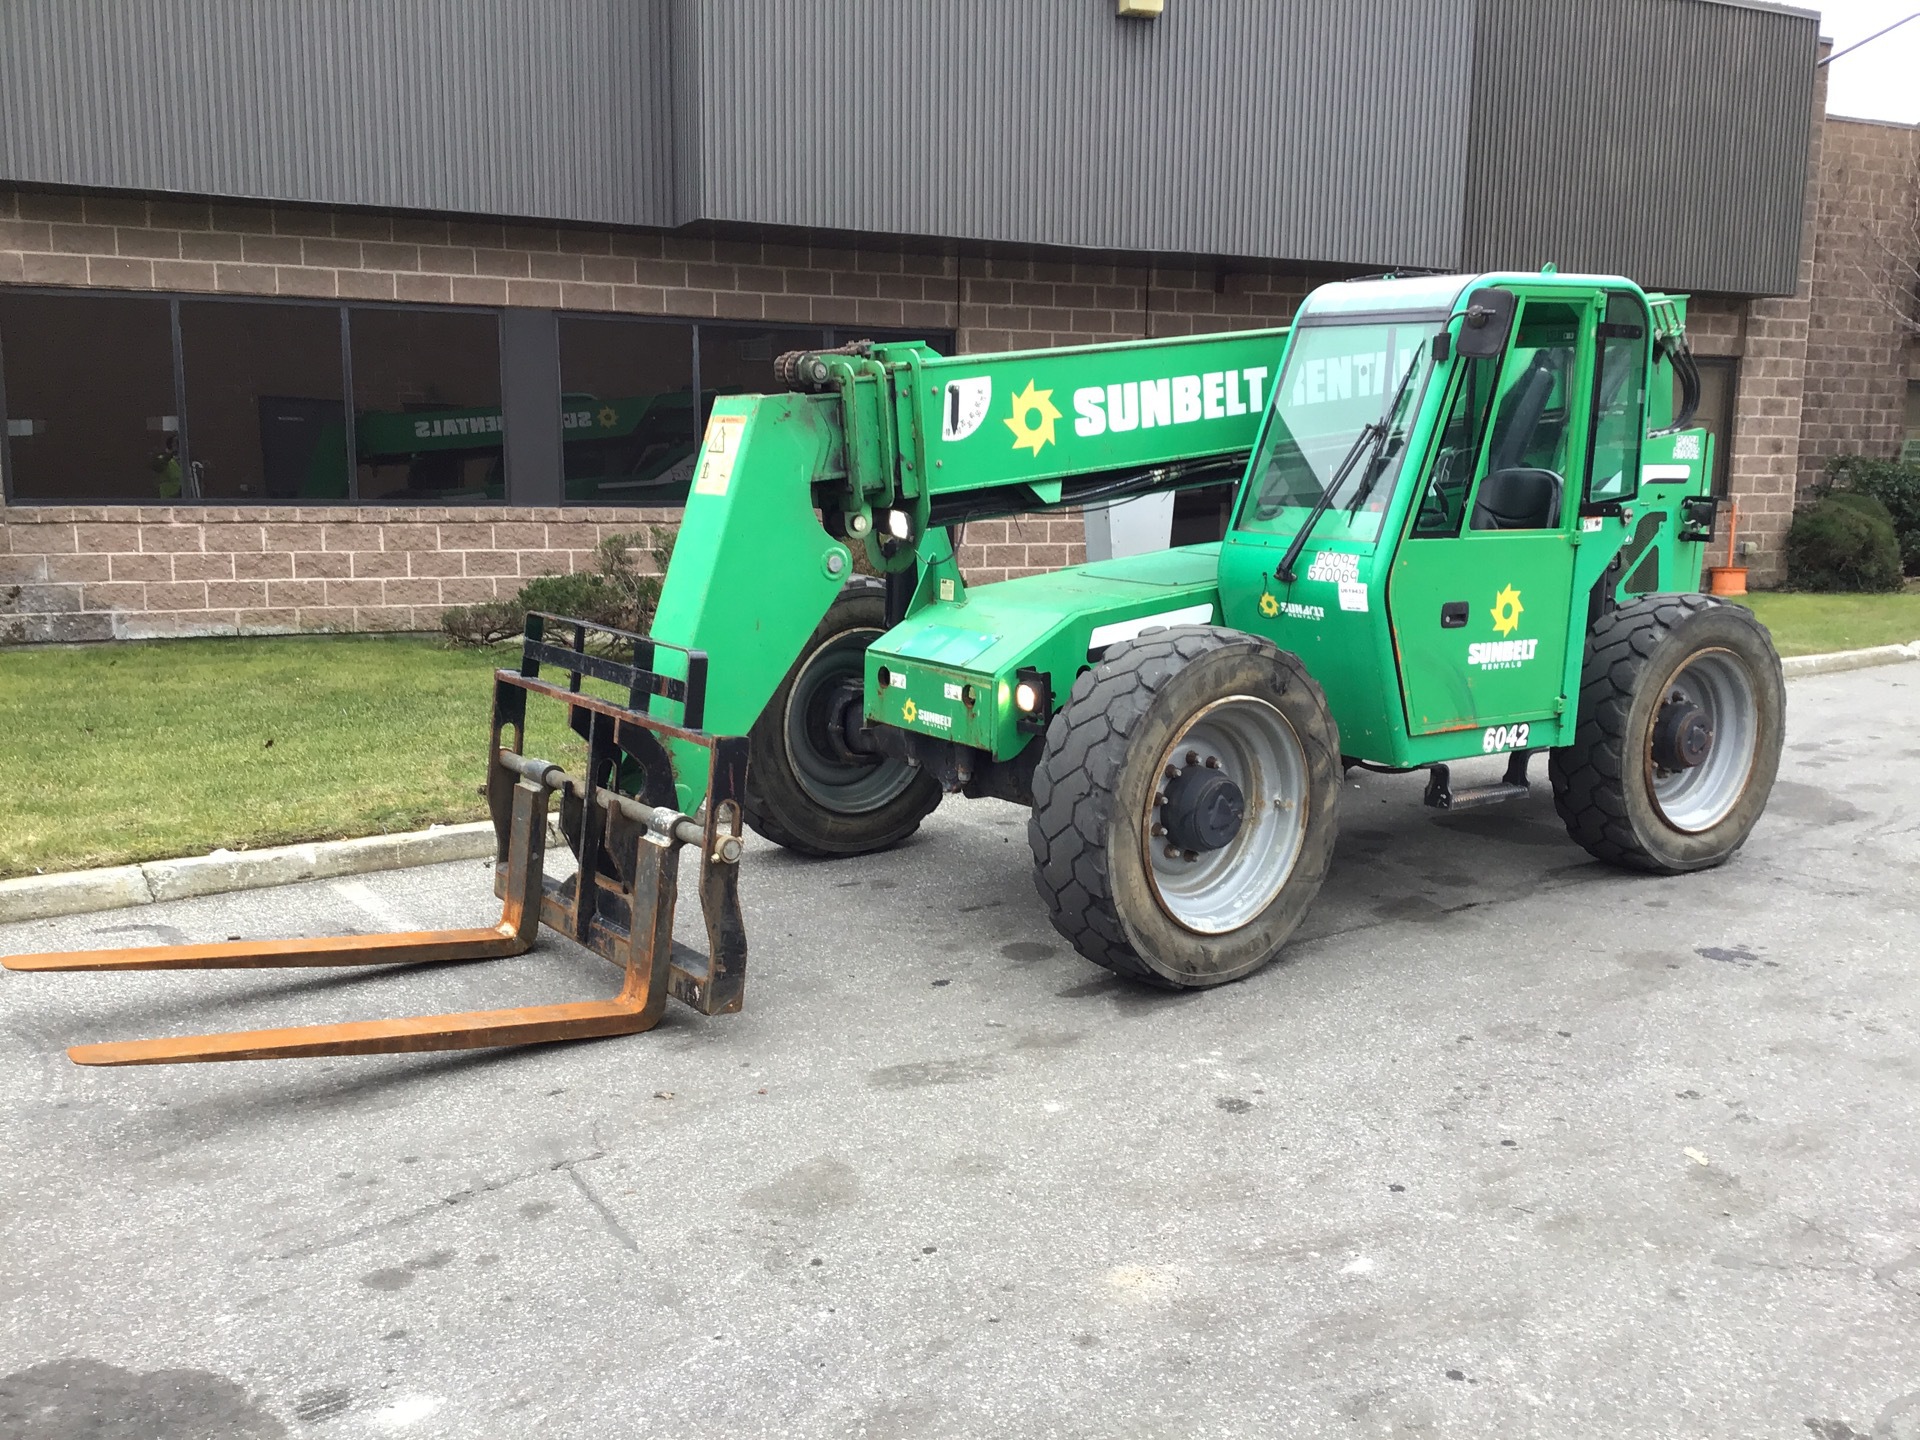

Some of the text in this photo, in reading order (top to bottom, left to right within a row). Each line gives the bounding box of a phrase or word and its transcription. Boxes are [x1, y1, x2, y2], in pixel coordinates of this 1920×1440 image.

[1073, 366, 1268, 437] SUNBELT
[1316, 552, 1357, 568] PC094
[1308, 565, 1358, 583] 570069
[1468, 638, 1538, 665] SUNBELT
[1481, 662, 1522, 671] RENTALS
[917, 709, 952, 728] SUNBELT
[1483, 723, 1530, 752] 6042
